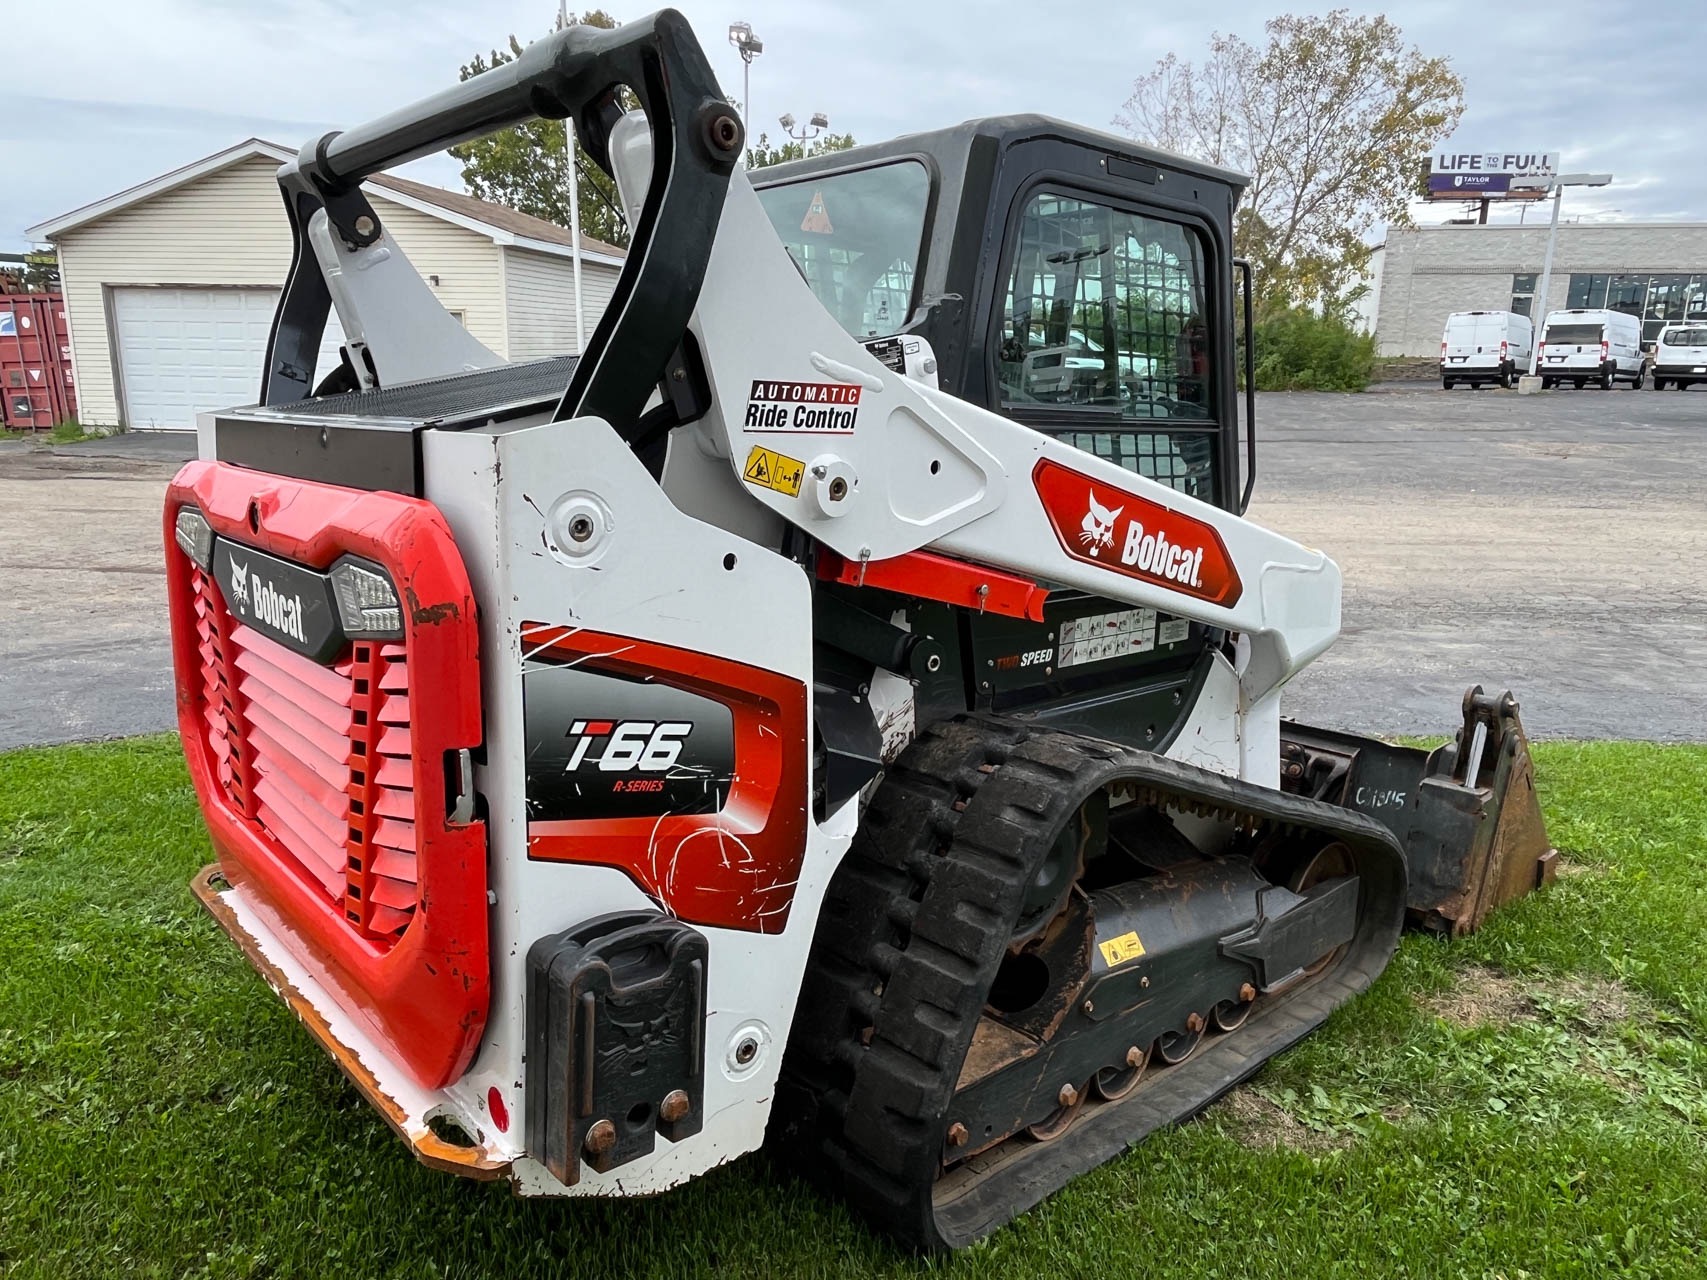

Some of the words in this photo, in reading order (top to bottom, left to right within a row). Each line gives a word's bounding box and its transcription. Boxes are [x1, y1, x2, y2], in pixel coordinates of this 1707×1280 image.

[1439, 154, 1482, 170] LIFE
[1502, 154, 1551, 170] FULL
[754, 384, 857, 403] AUTOMATIC
[745, 403, 788, 428] Ride
[793, 405, 858, 429] Control
[1121, 519, 1203, 588] Bobcat
[251, 573, 304, 643] Bobcat
[1020, 648, 1054, 667] SPEED
[565, 720, 692, 772] T66
[613, 780, 665, 792] R-SERIES
